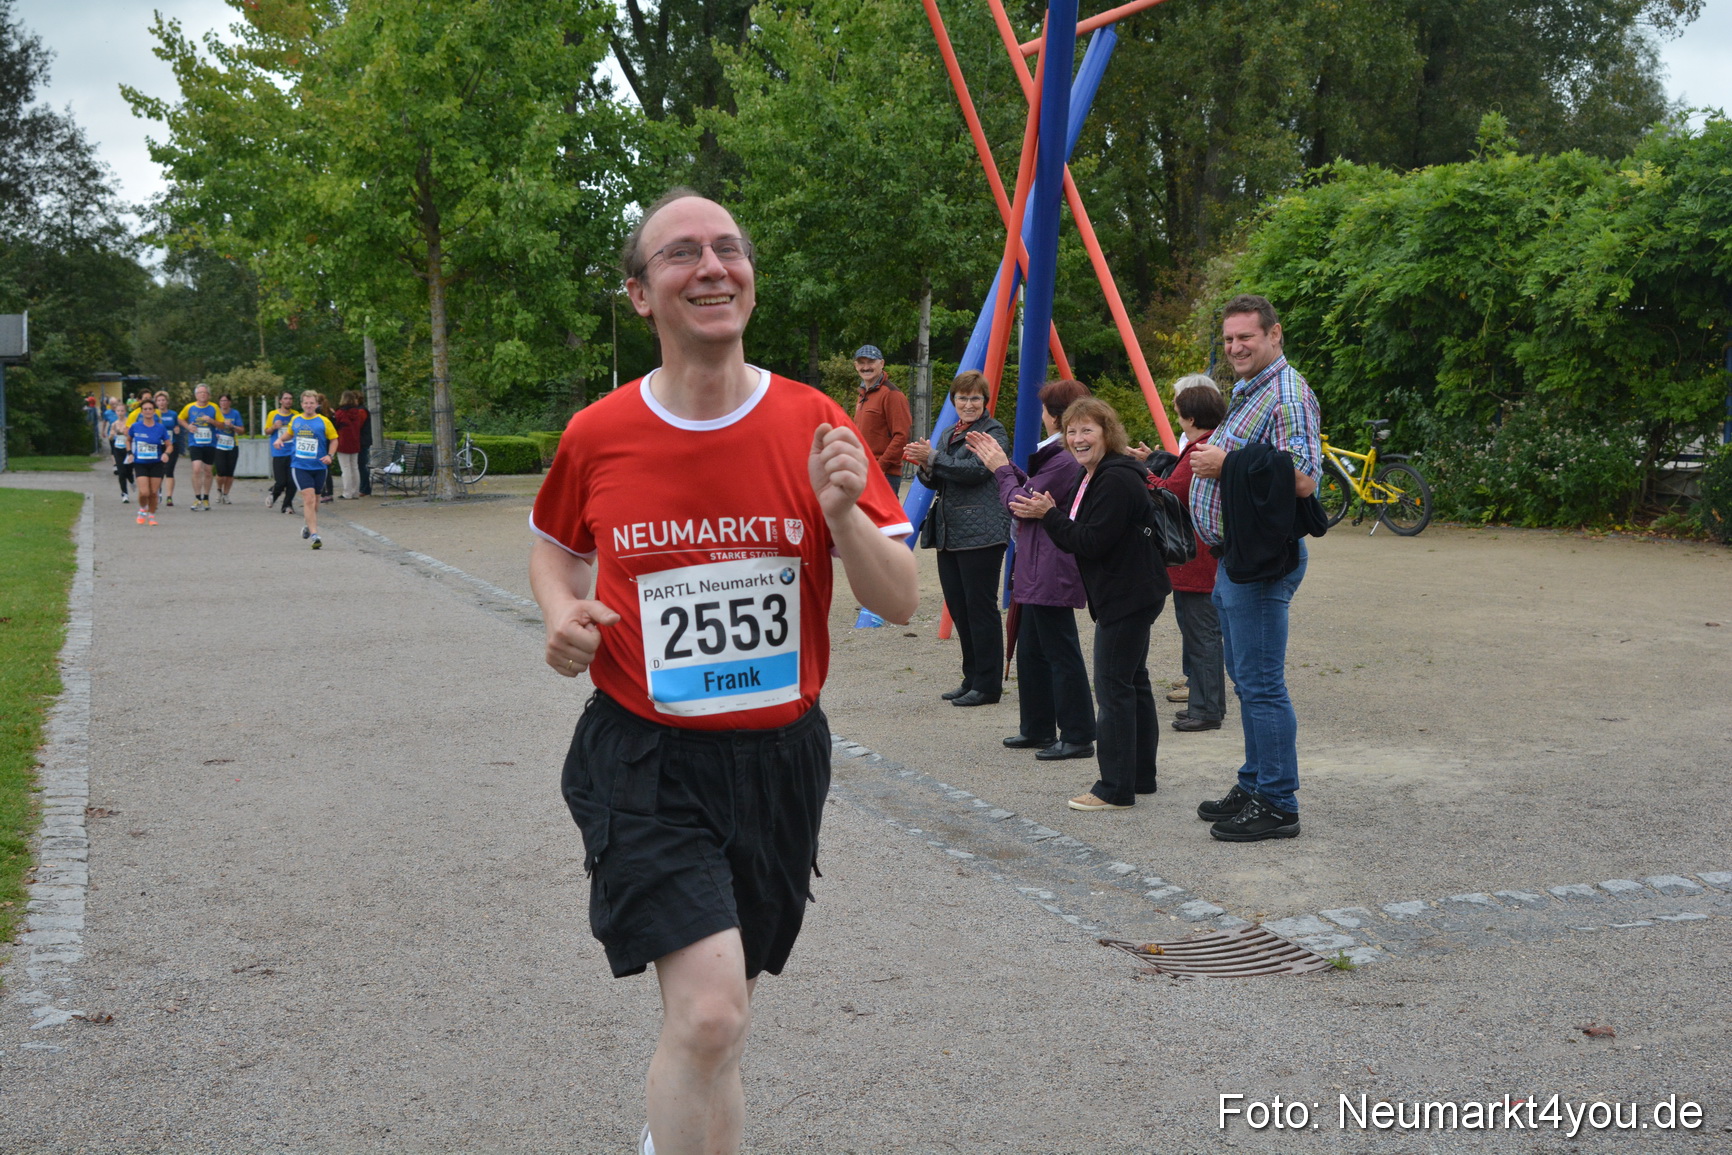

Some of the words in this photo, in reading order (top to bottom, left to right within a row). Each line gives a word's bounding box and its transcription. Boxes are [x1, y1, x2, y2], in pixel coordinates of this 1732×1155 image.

[297, 441, 316, 451] 2576
[612, 516, 777, 551] NEUMARKT
[709, 551, 747, 561] STARKE
[749, 551, 779, 560] STADT
[643, 582, 696, 602] PARTL
[699, 573, 775, 593] Neumarkt
[660, 593, 789, 661] 2553
[653, 659, 660, 668] D
[703, 668, 761, 692] Frank
